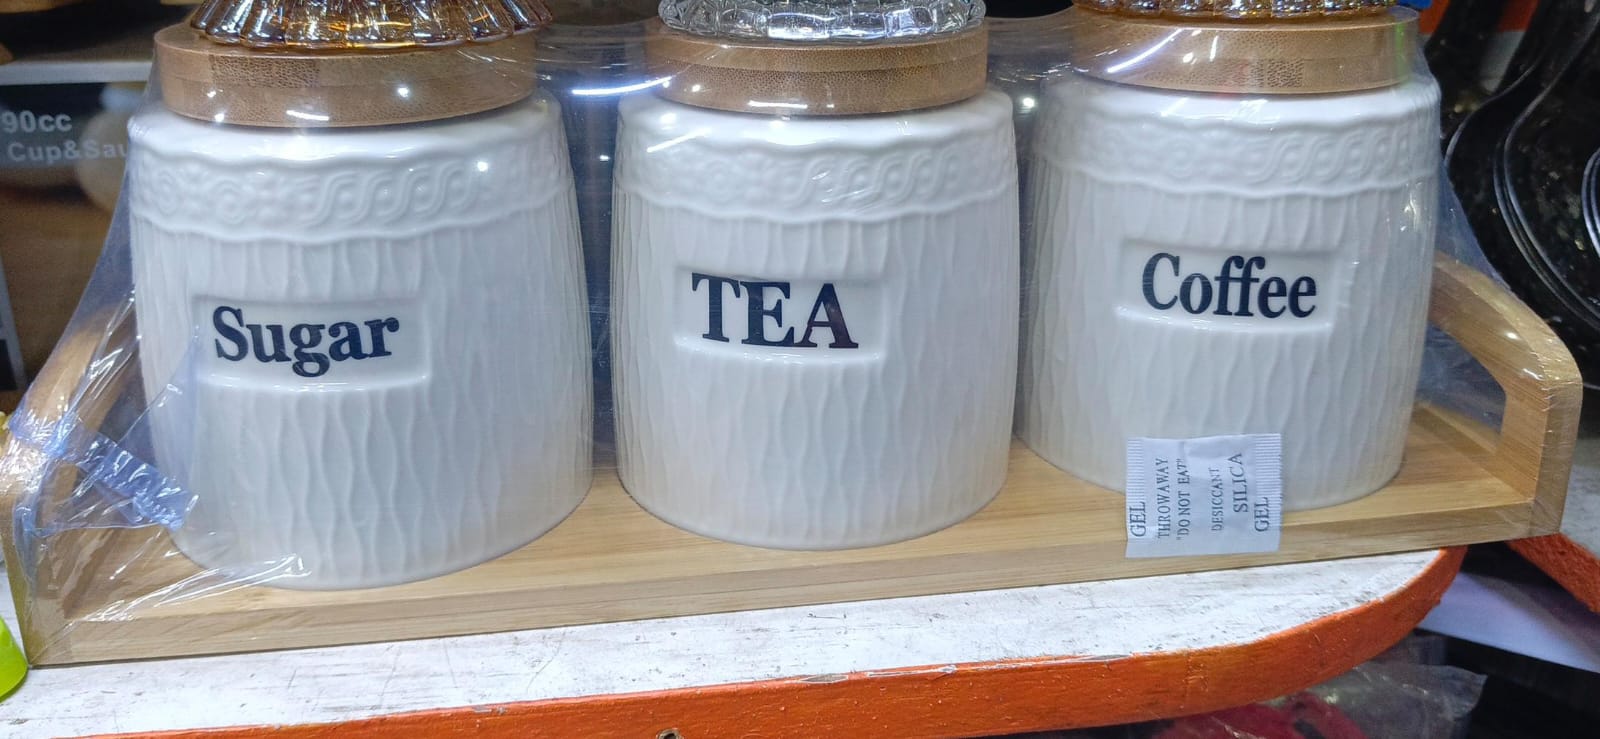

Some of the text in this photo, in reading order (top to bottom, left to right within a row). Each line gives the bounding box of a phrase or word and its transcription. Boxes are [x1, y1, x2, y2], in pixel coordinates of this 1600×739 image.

[691, 272, 859, 349] TEA
[1142, 252, 1317, 319] Coffee
[212, 305, 400, 378] Sugar
[1177, 491, 1191, 515] NOT
[1208, 467, 1224, 532] DESICCANT
[1227, 452, 1249, 513] SILICA
[1129, 501, 1147, 538] GEL
[1254, 497, 1270, 532] GEL
